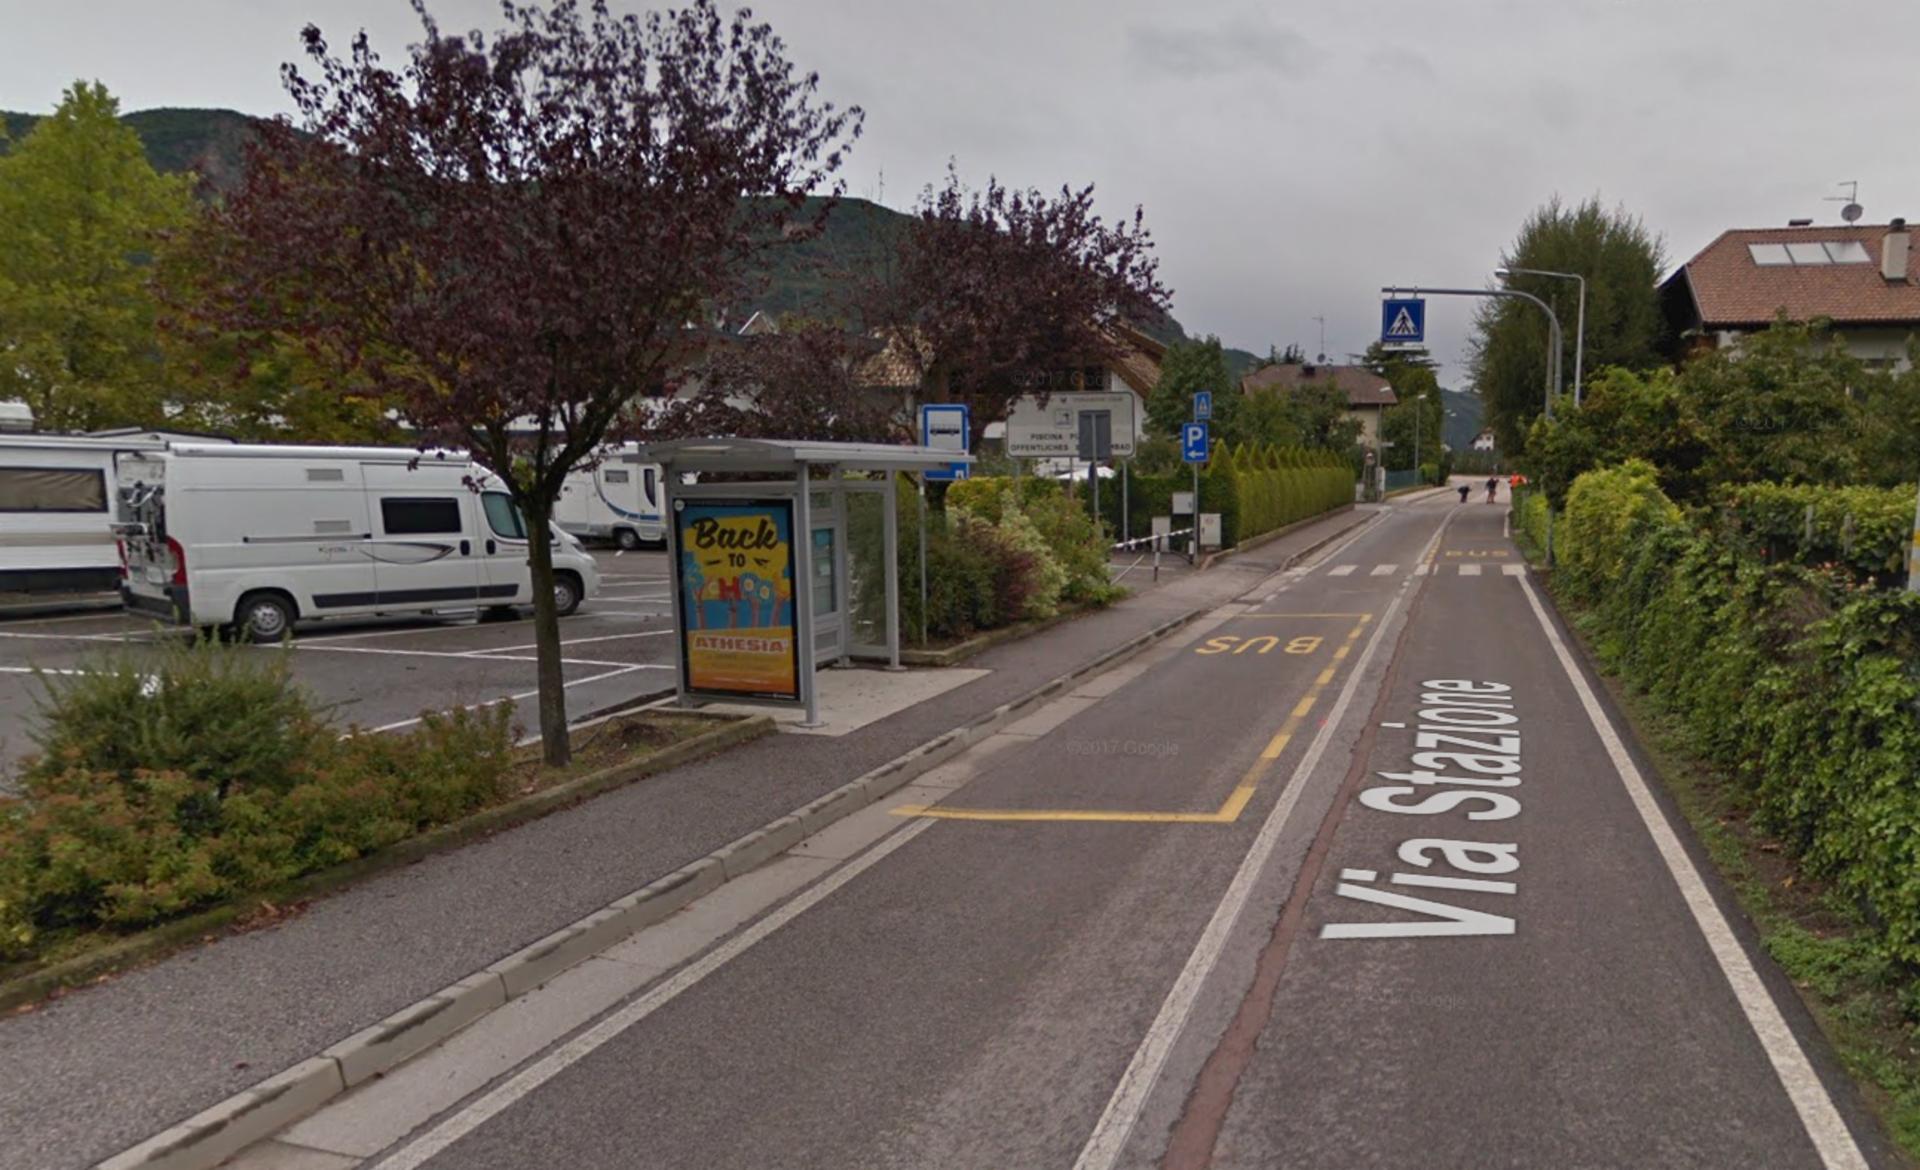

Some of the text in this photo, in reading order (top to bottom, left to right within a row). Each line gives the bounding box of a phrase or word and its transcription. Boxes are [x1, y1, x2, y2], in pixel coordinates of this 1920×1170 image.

[1187, 426, 1204, 447] P
[691, 516, 779, 550] Back
[728, 553, 746, 568] TO
[1446, 549, 1509, 558] BUS
[695, 636, 785, 652] ATHESIA
[1194, 635, 1324, 654] BUS
